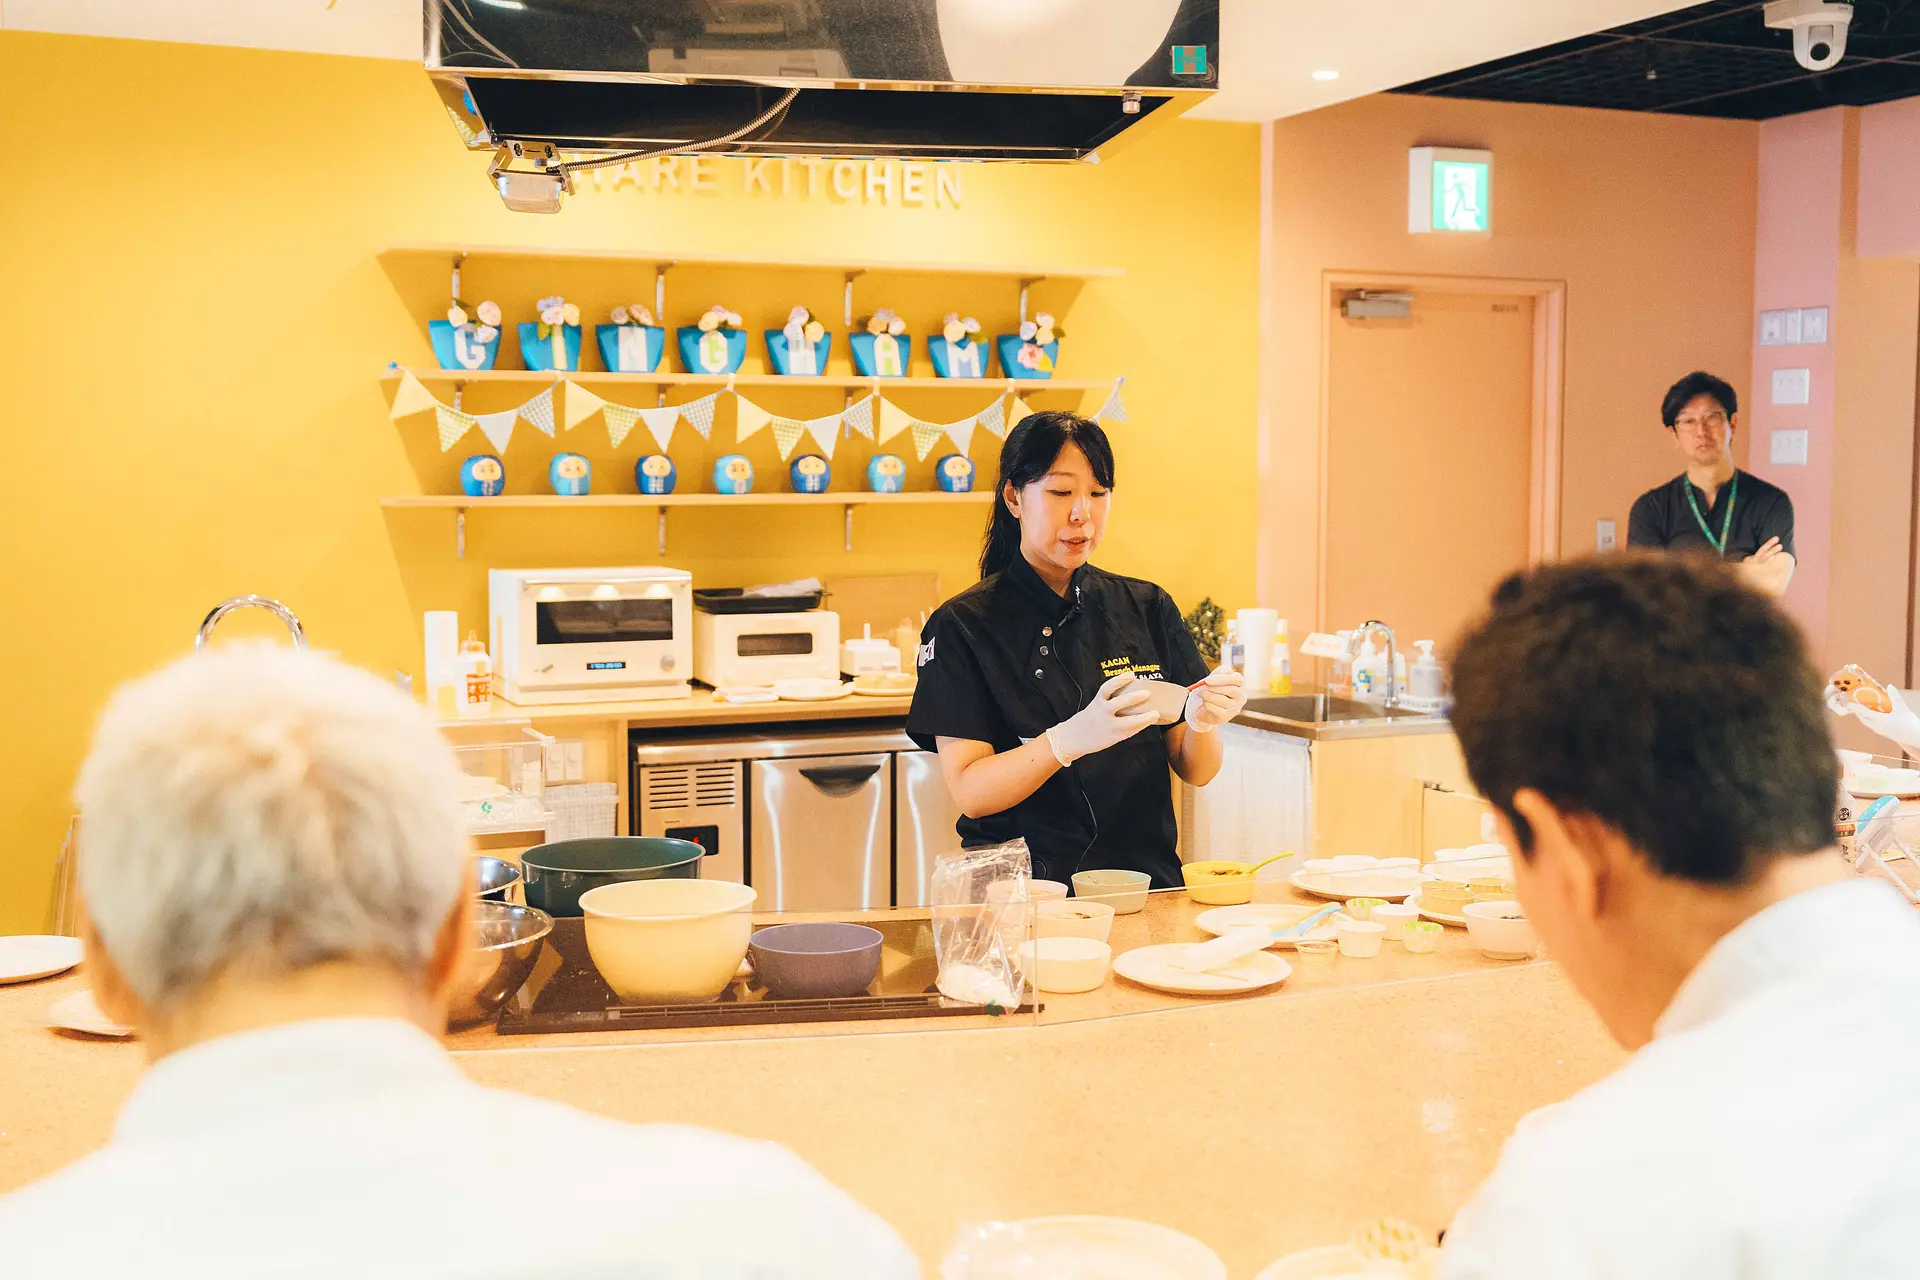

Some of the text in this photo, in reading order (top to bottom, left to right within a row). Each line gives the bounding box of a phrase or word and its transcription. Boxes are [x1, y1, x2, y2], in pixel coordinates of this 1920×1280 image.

[744, 158, 962, 202] KITCHEN
[1103, 664, 1160, 677] Branch Manager
